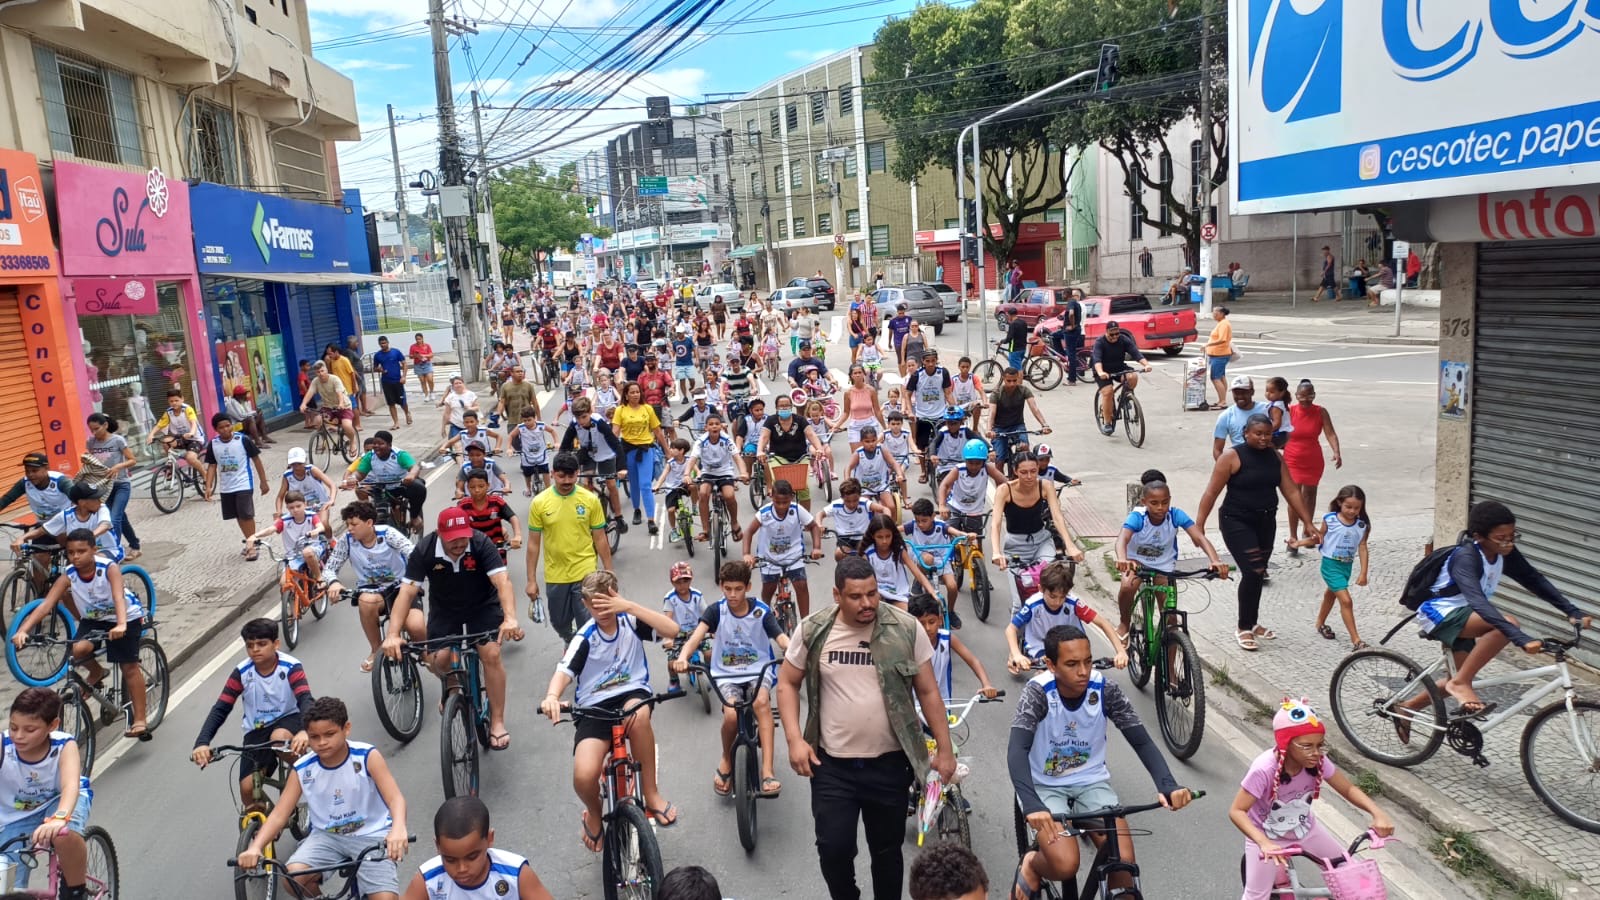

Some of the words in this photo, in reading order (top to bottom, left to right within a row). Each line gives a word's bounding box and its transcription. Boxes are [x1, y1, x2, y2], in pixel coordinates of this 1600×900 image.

[19, 192, 41, 209] Itaú
[1478, 187, 1600, 240] Inta
[269, 218, 314, 251] Farmes
[1441, 318, 1471, 338] 573
